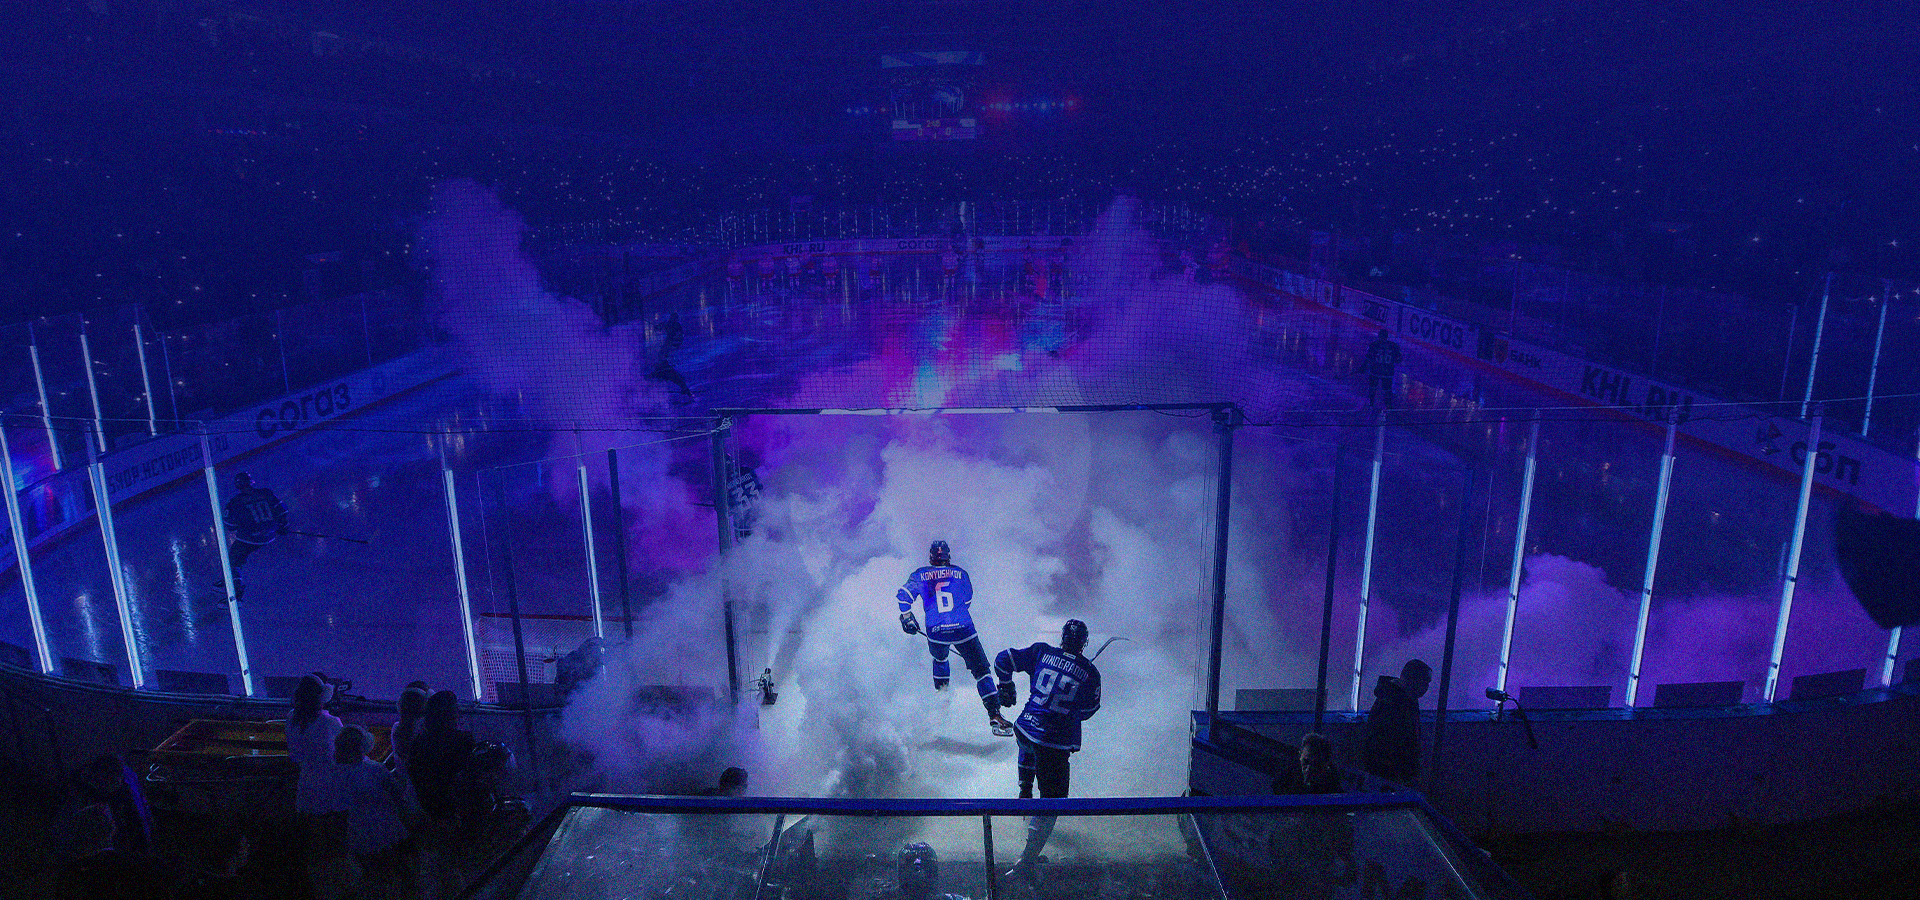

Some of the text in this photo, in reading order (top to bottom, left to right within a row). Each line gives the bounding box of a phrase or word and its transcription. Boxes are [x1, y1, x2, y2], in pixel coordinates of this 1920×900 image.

[107, 434, 229, 494] SHOP.HCTORPED.RU
[246, 501, 273, 523] 10
[920, 569, 962, 581] KONYUSHKOV
[935, 580, 955, 614] 6
[1032, 667, 1080, 714] 92
